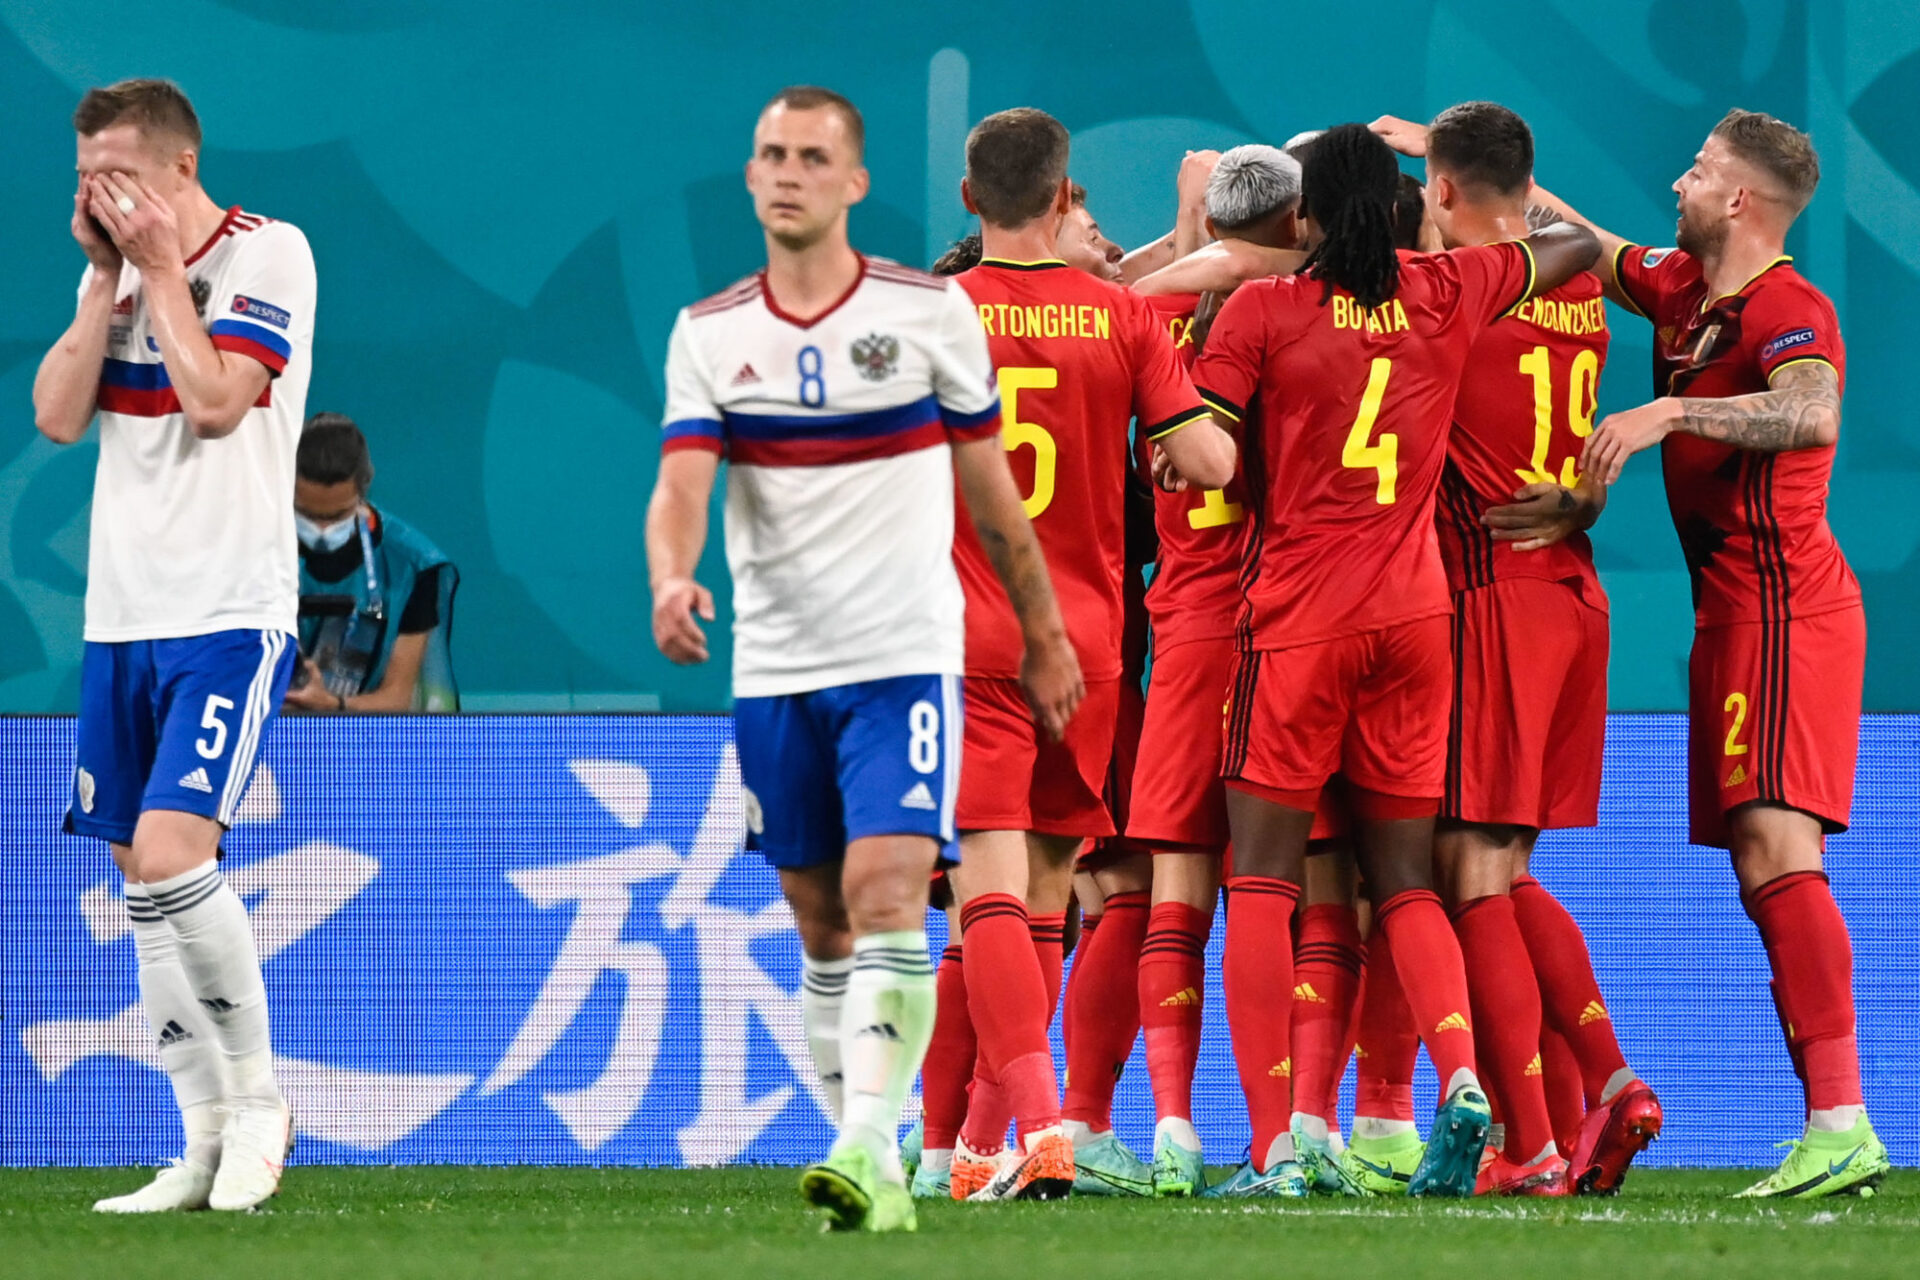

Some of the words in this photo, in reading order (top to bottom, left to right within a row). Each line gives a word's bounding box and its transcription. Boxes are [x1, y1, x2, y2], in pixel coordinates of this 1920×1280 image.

[248, 303, 290, 325] RESPECT
[974, 304, 1110, 339] RTONGHEN
[1509, 296, 1605, 335] ENDONCKER
[1773, 331, 1813, 350] RESPECT
[797, 346, 826, 409] 8
[997, 367, 1058, 520] 5
[1342, 358, 1398, 504] 4
[1514, 346, 1599, 489] 19
[195, 694, 234, 760] 5
[908, 700, 939, 774] 8
[1724, 692, 1748, 756] 2
